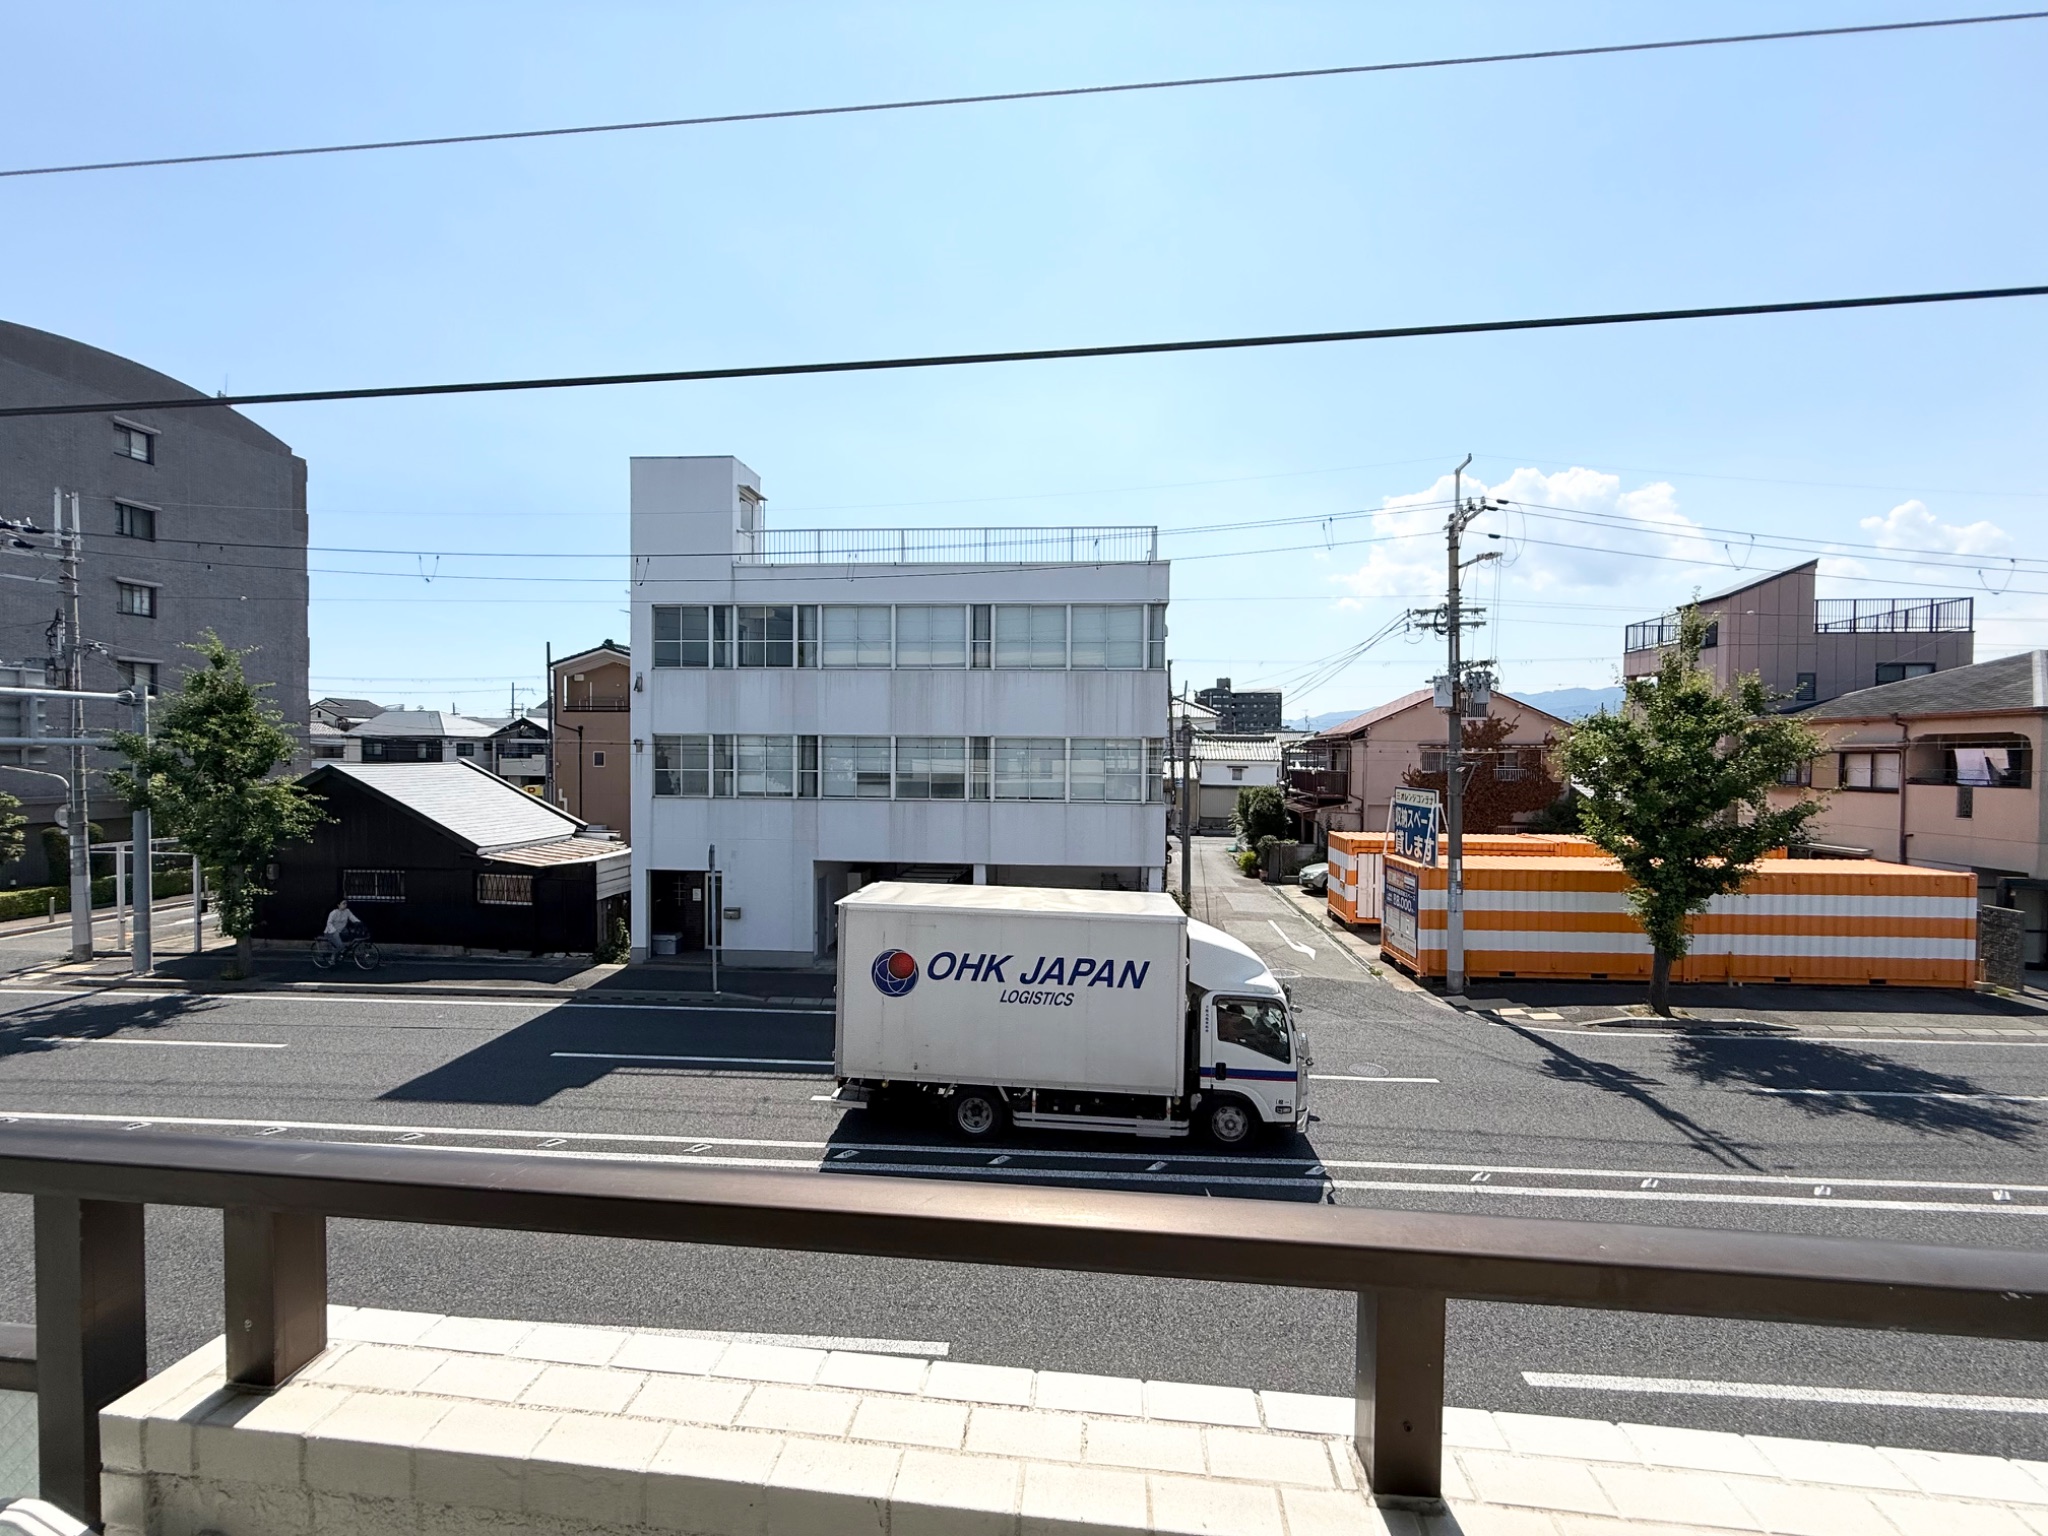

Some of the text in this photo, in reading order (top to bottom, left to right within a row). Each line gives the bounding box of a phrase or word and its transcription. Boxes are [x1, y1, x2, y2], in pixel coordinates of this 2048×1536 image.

[1395, 829, 1435, 862] 貸します
[927, 951, 1151, 989] OHK JAPAN
[1000, 989, 1075, 1007] LOGISTICS
